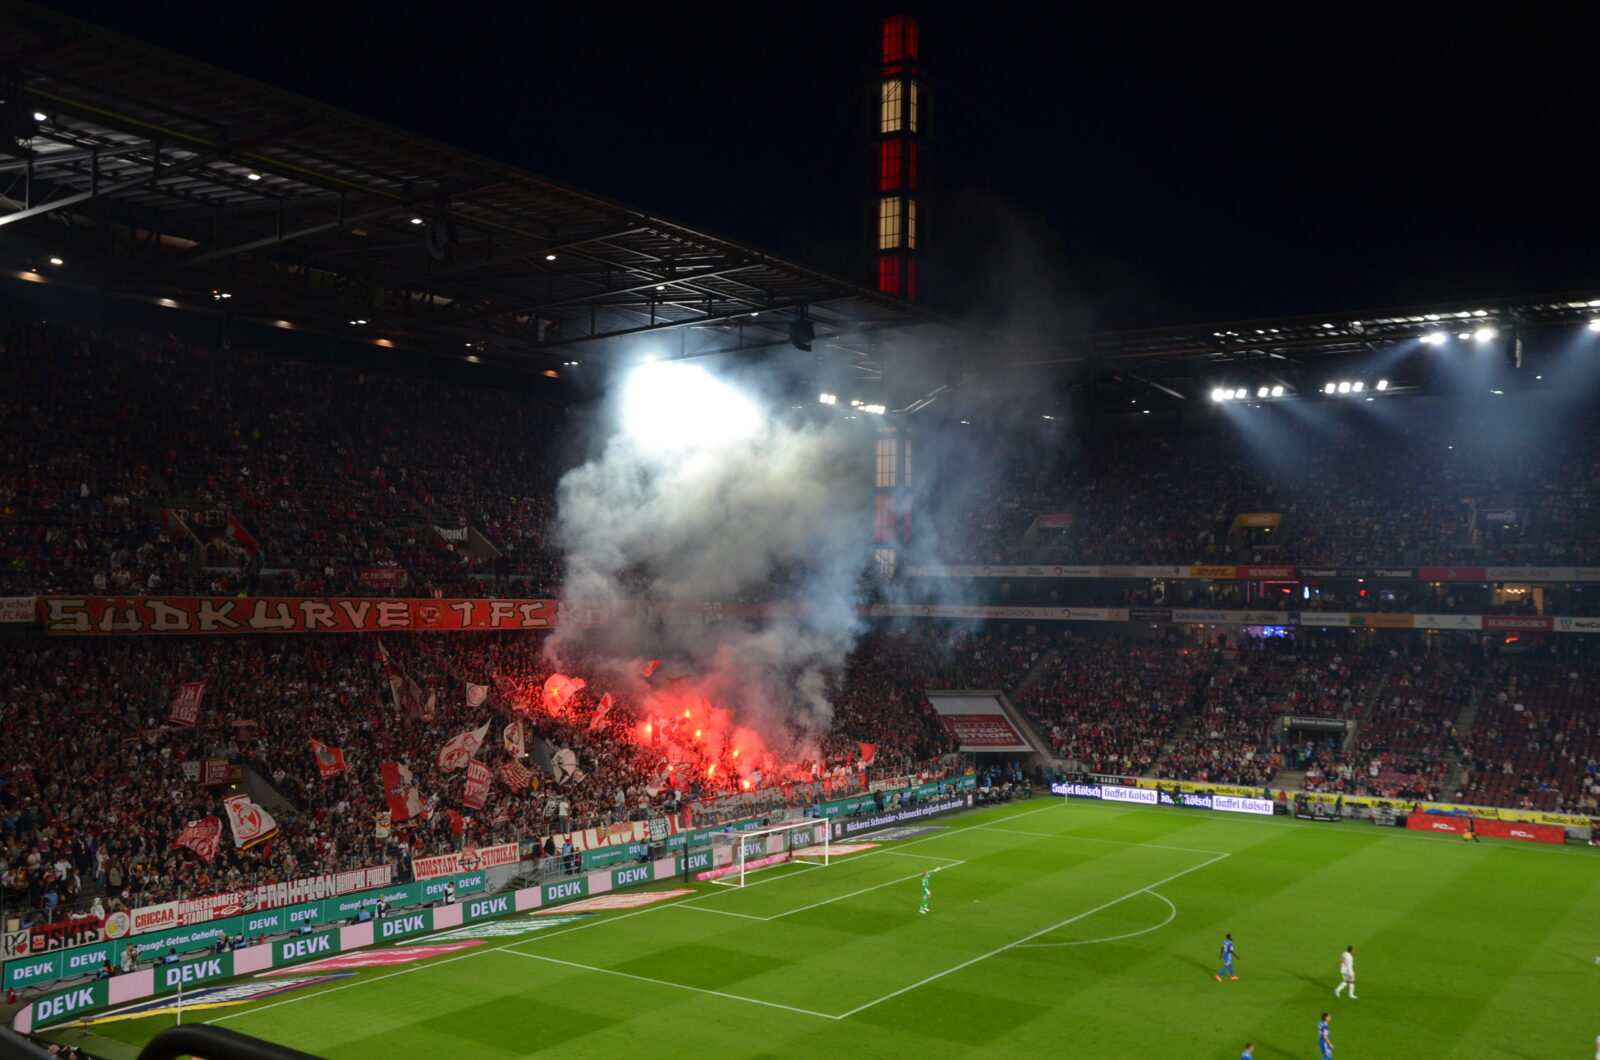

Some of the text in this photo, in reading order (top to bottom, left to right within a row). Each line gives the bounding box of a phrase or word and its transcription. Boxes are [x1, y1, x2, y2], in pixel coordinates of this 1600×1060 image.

[47, 598, 410, 632] SÜDKURVE
[1487, 619, 1548, 628] HAGEDORN
[1075, 784, 1101, 798] Kölsch
[1104, 787, 1127, 799] Gaffel
[1128, 789, 1155, 802] Kölsch
[1215, 797, 1270, 812] Gaffel Kölsch
[898, 809, 922, 821] Schmeckt
[670, 837, 686, 846] DEVK
[415, 845, 518, 878] DOMSTADT SYNDIKAT
[681, 854, 708, 870] DEVK
[459, 877, 481, 889] DEVK
[618, 867, 648, 885] DEVK
[549, 881, 581, 900] DEVK
[340, 901, 361, 911] Gesagt.
[471, 897, 508, 917] DEVK
[249, 917, 278, 930] DEVK
[291, 908, 318, 922] DEVK
[382, 914, 425, 937] DEVK
[136, 940, 165, 952] Gesagt.
[166, 935, 190, 947] Getan.
[283, 934, 331, 960] DEVK
[70, 951, 107, 968] DEVK
[13, 961, 54, 980] DEVK
[166, 958, 222, 986] DEVK
[37, 987, 95, 1021] DEVK
